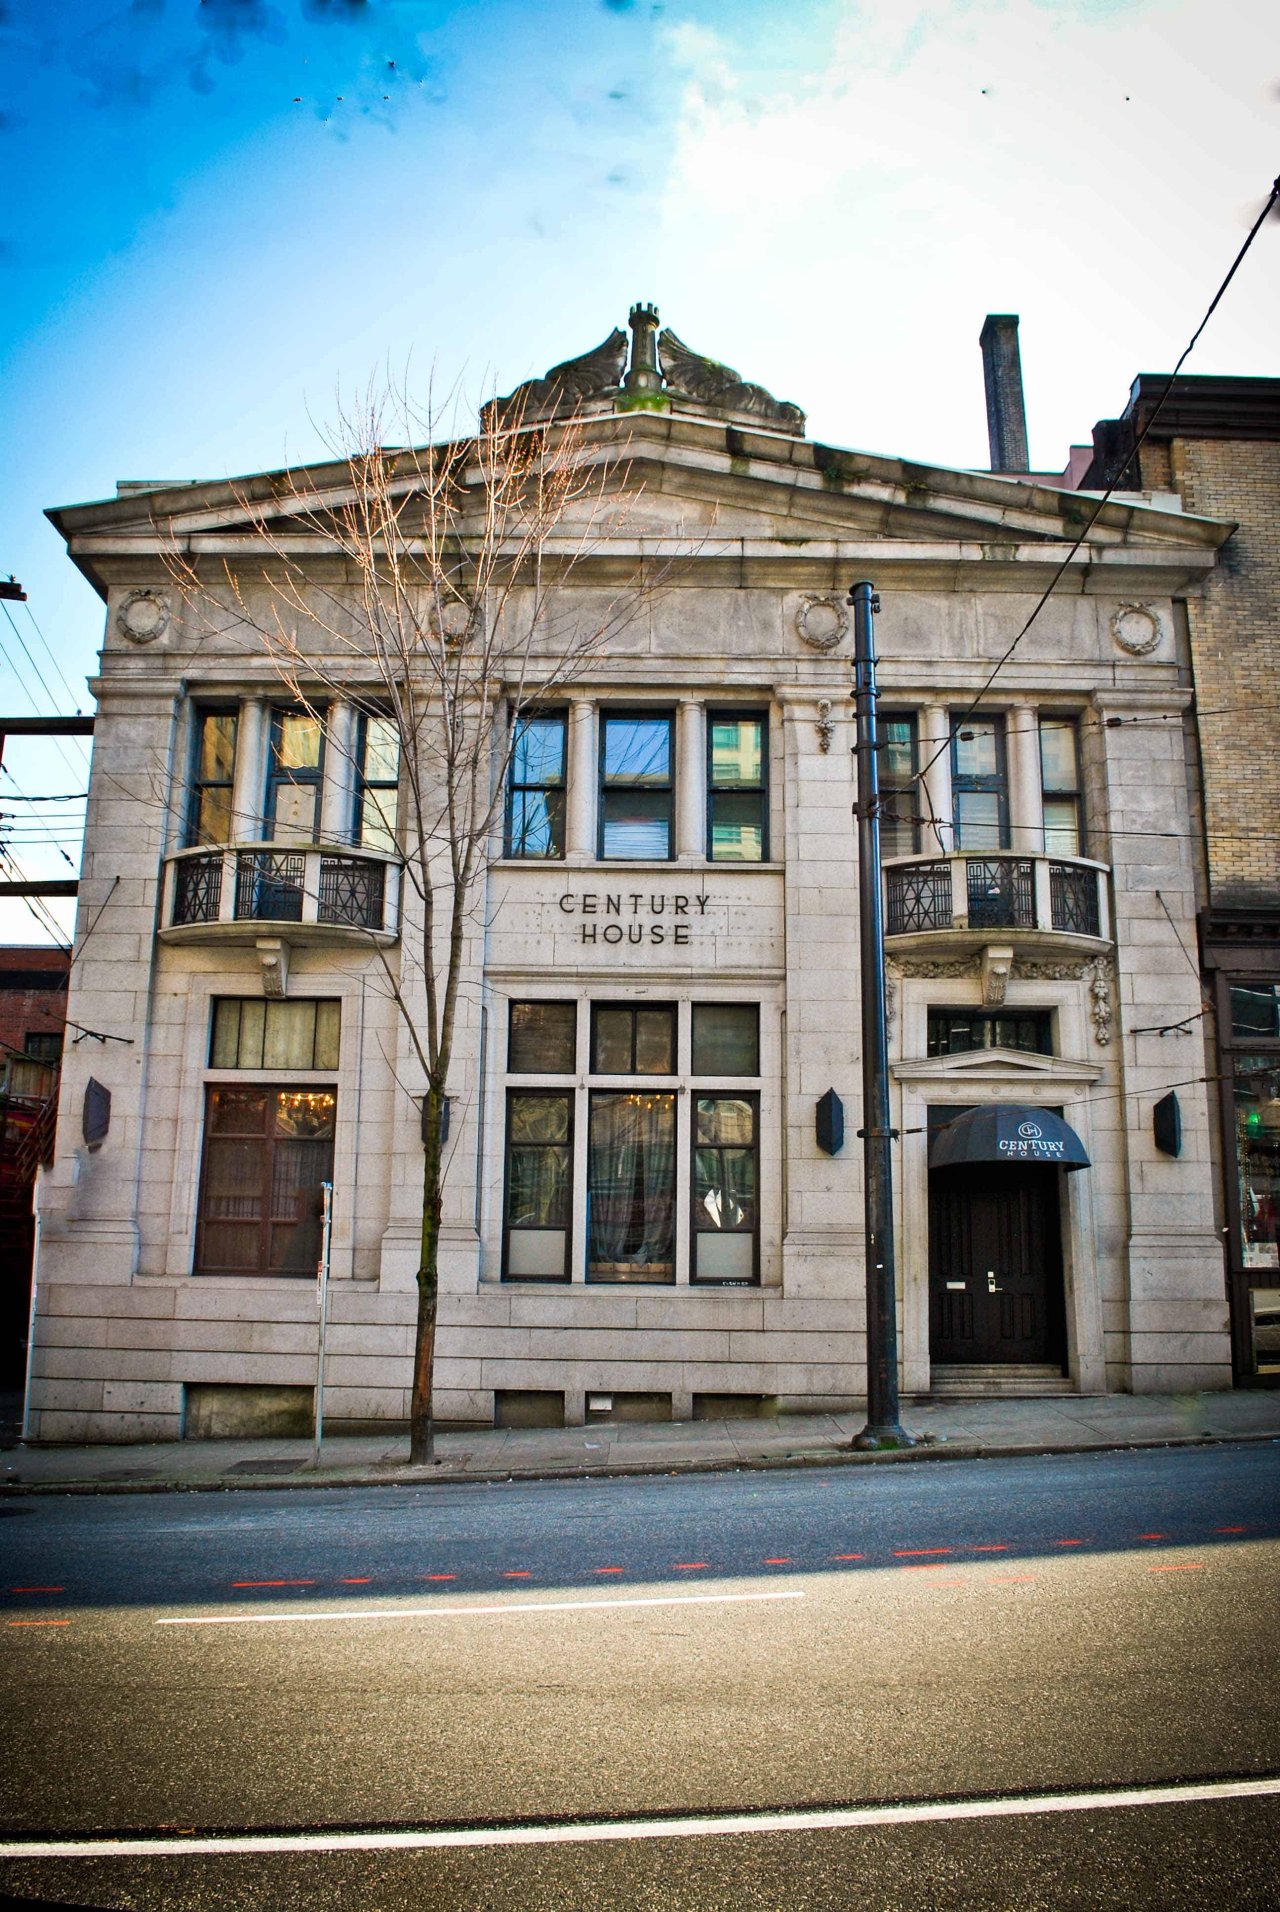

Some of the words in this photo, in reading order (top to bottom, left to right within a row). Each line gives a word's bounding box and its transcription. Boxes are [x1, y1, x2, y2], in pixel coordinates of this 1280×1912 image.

[559, 894, 710, 916] CENTURY
[582, 924, 689, 944] HOUSE
[999, 1139, 1065, 1151] CENTURY
